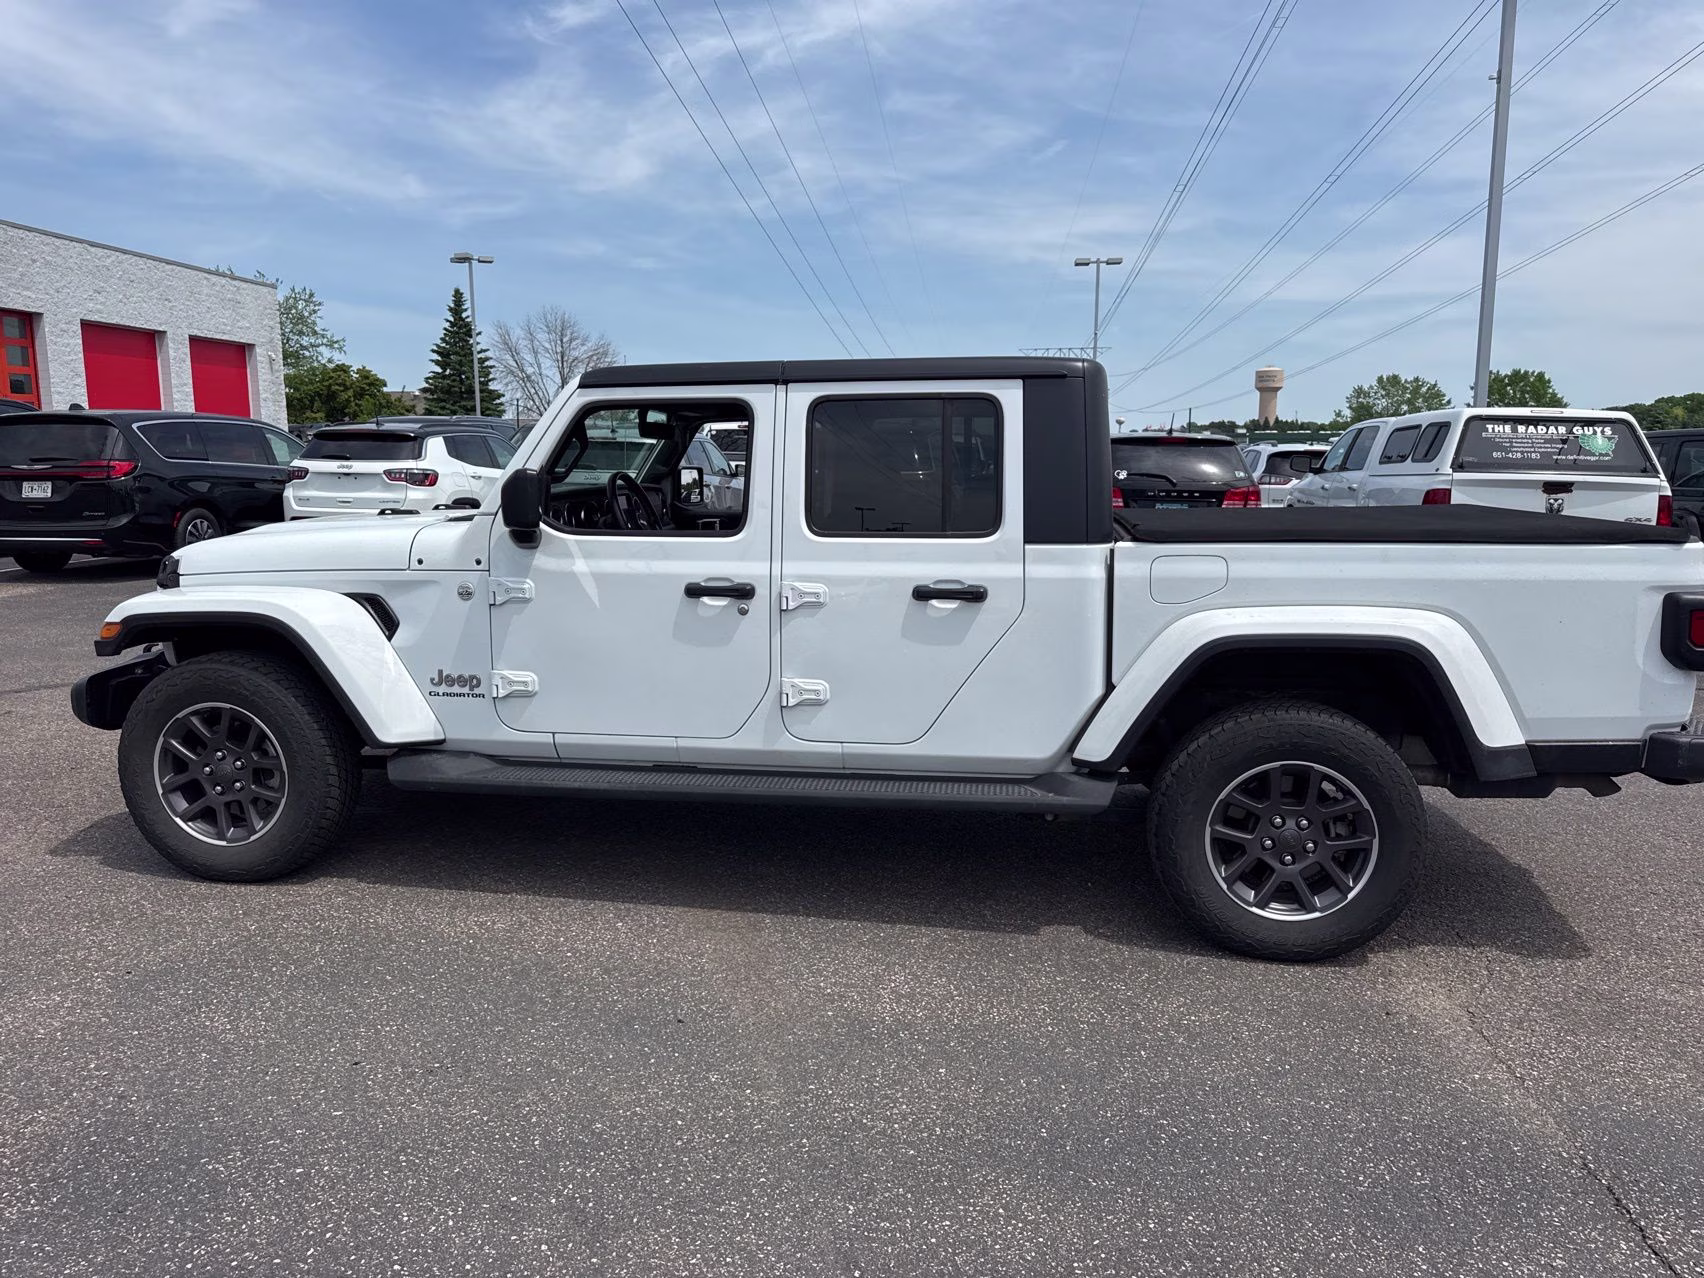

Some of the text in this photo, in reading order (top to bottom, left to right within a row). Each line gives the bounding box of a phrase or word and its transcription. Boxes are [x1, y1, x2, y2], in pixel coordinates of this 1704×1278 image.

[1486, 424, 1612, 436] THE RADAR GUYS
[430, 668, 481, 692] Jeep
[429, 690, 485, 699] GLADIATOR
